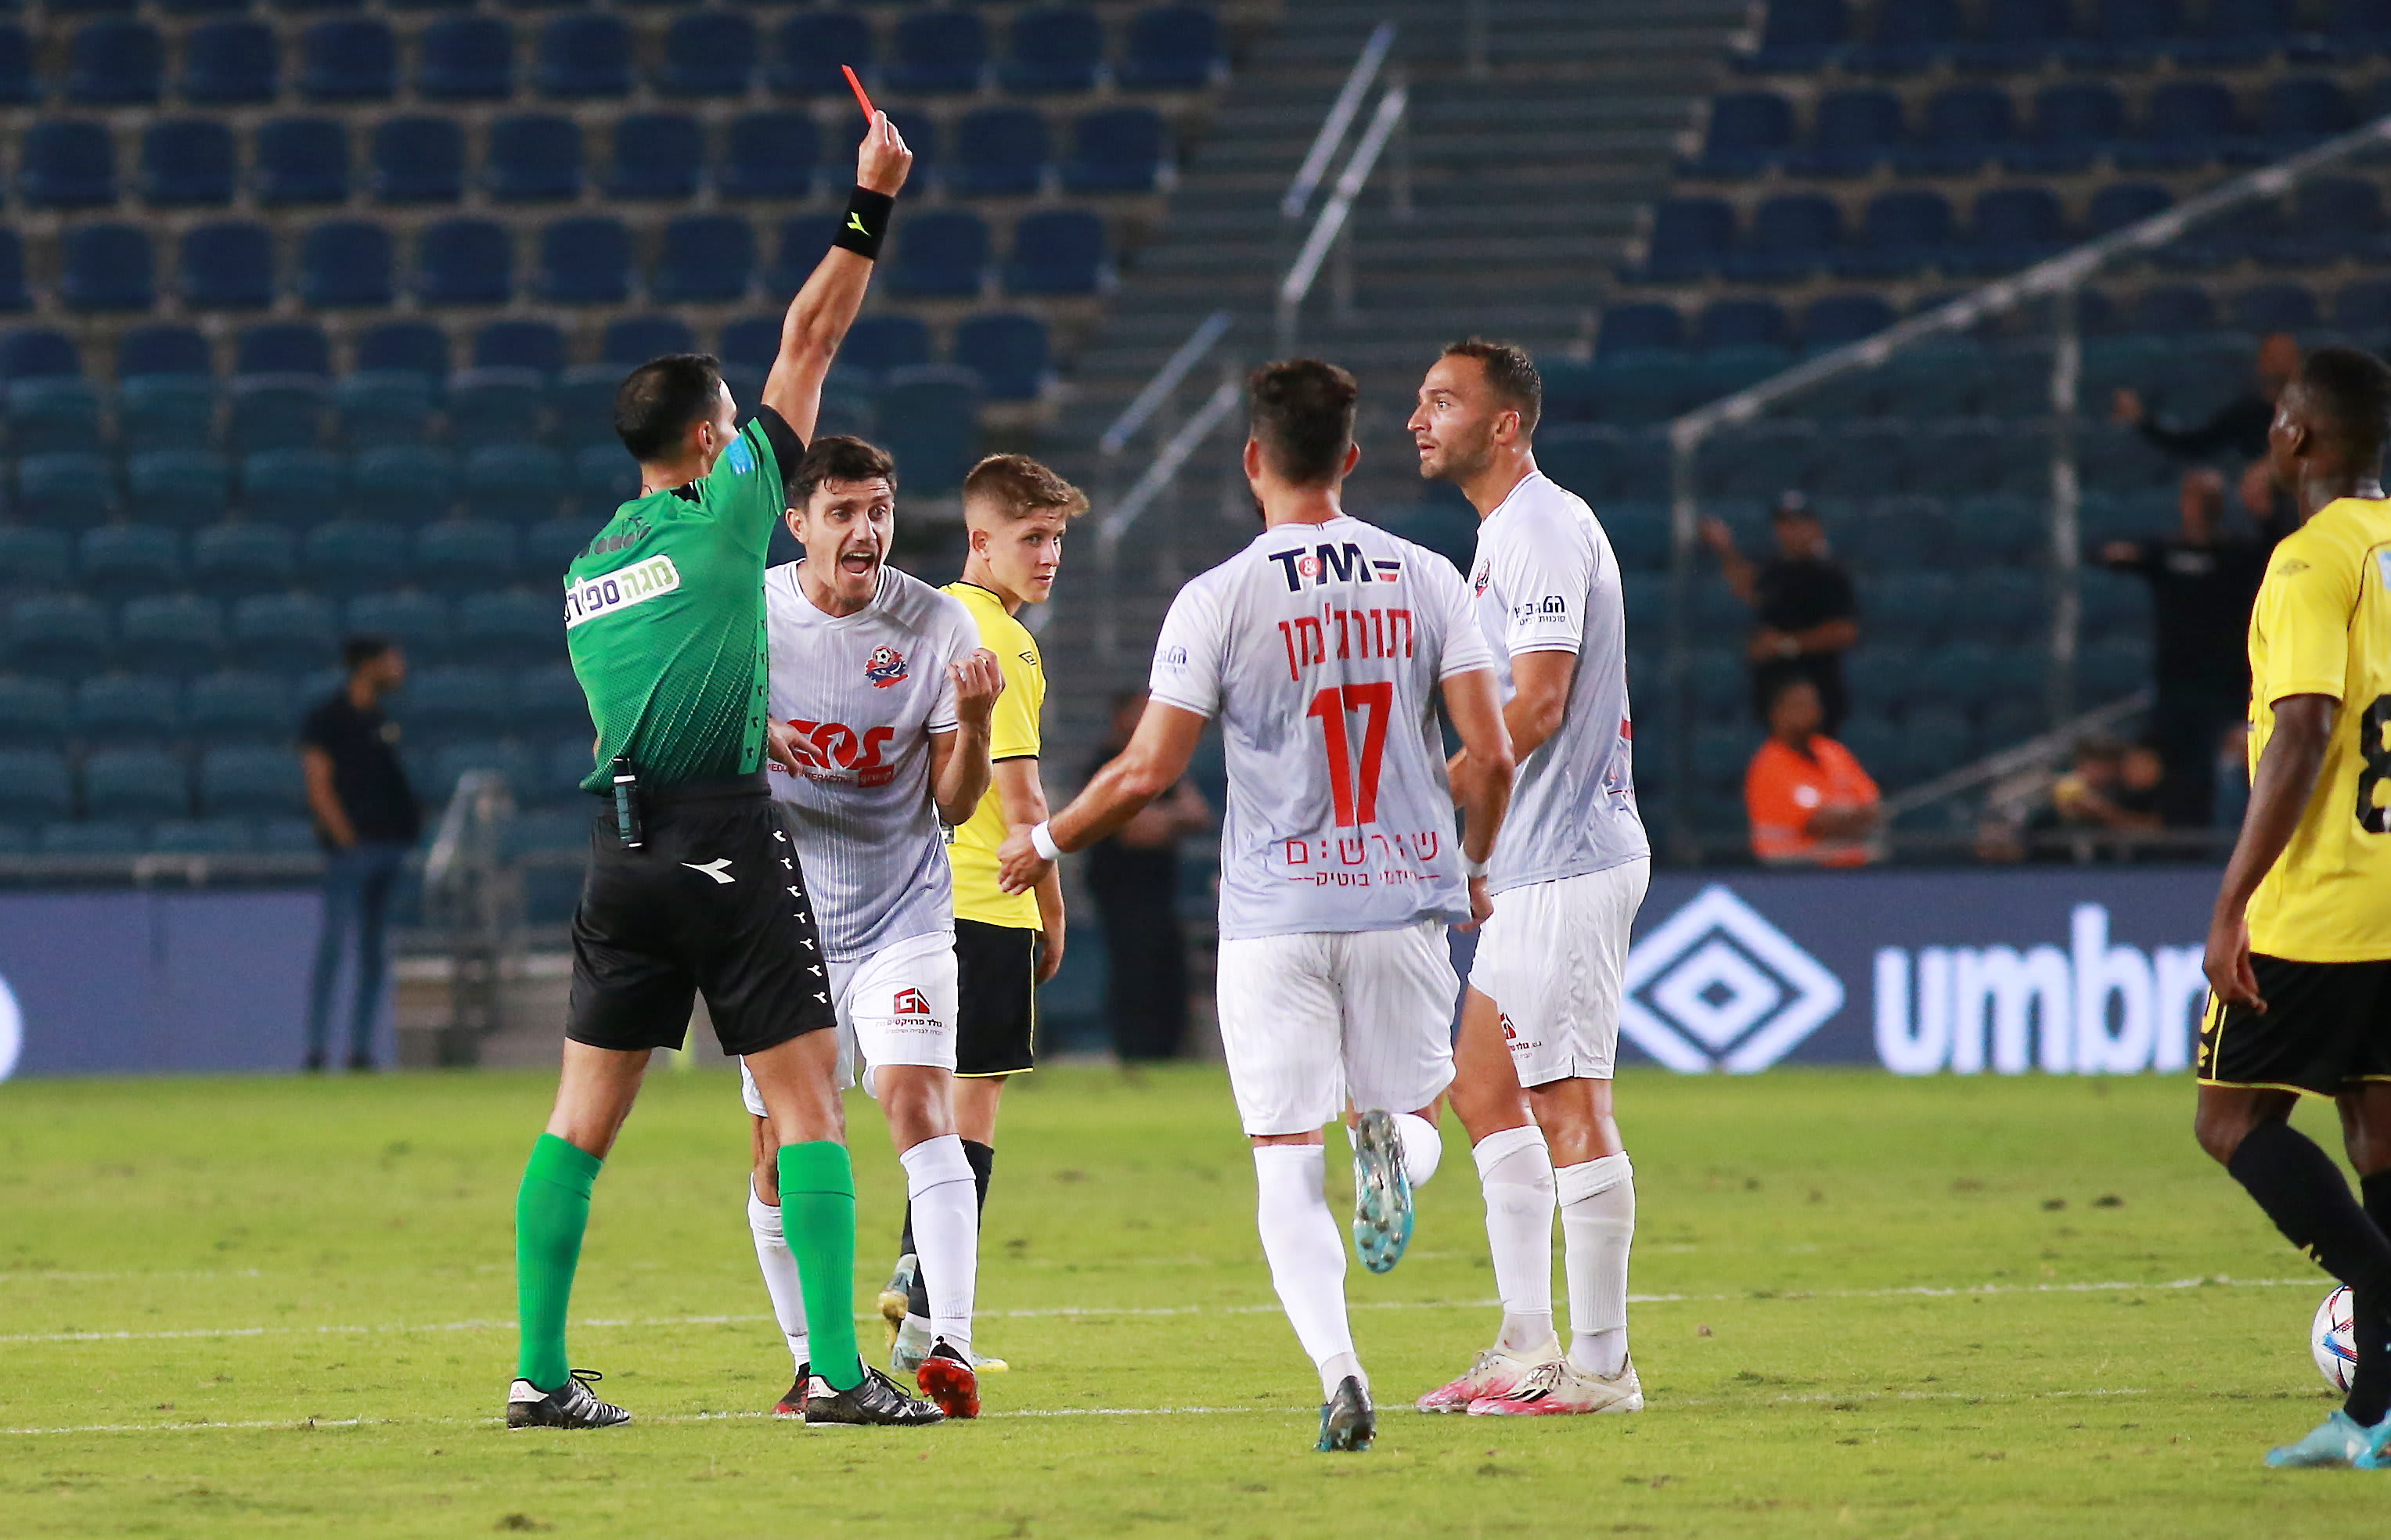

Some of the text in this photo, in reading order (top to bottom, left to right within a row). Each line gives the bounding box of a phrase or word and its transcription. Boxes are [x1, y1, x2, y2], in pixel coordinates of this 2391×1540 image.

[564, 560, 675, 623] מגה ספר
[1278, 603, 1413, 682] תורג'מן
[1306, 682, 1393, 828] 17
[1316, 872, 1370, 887] בוטיק
[1873, 901, 2207, 1077] umbr
